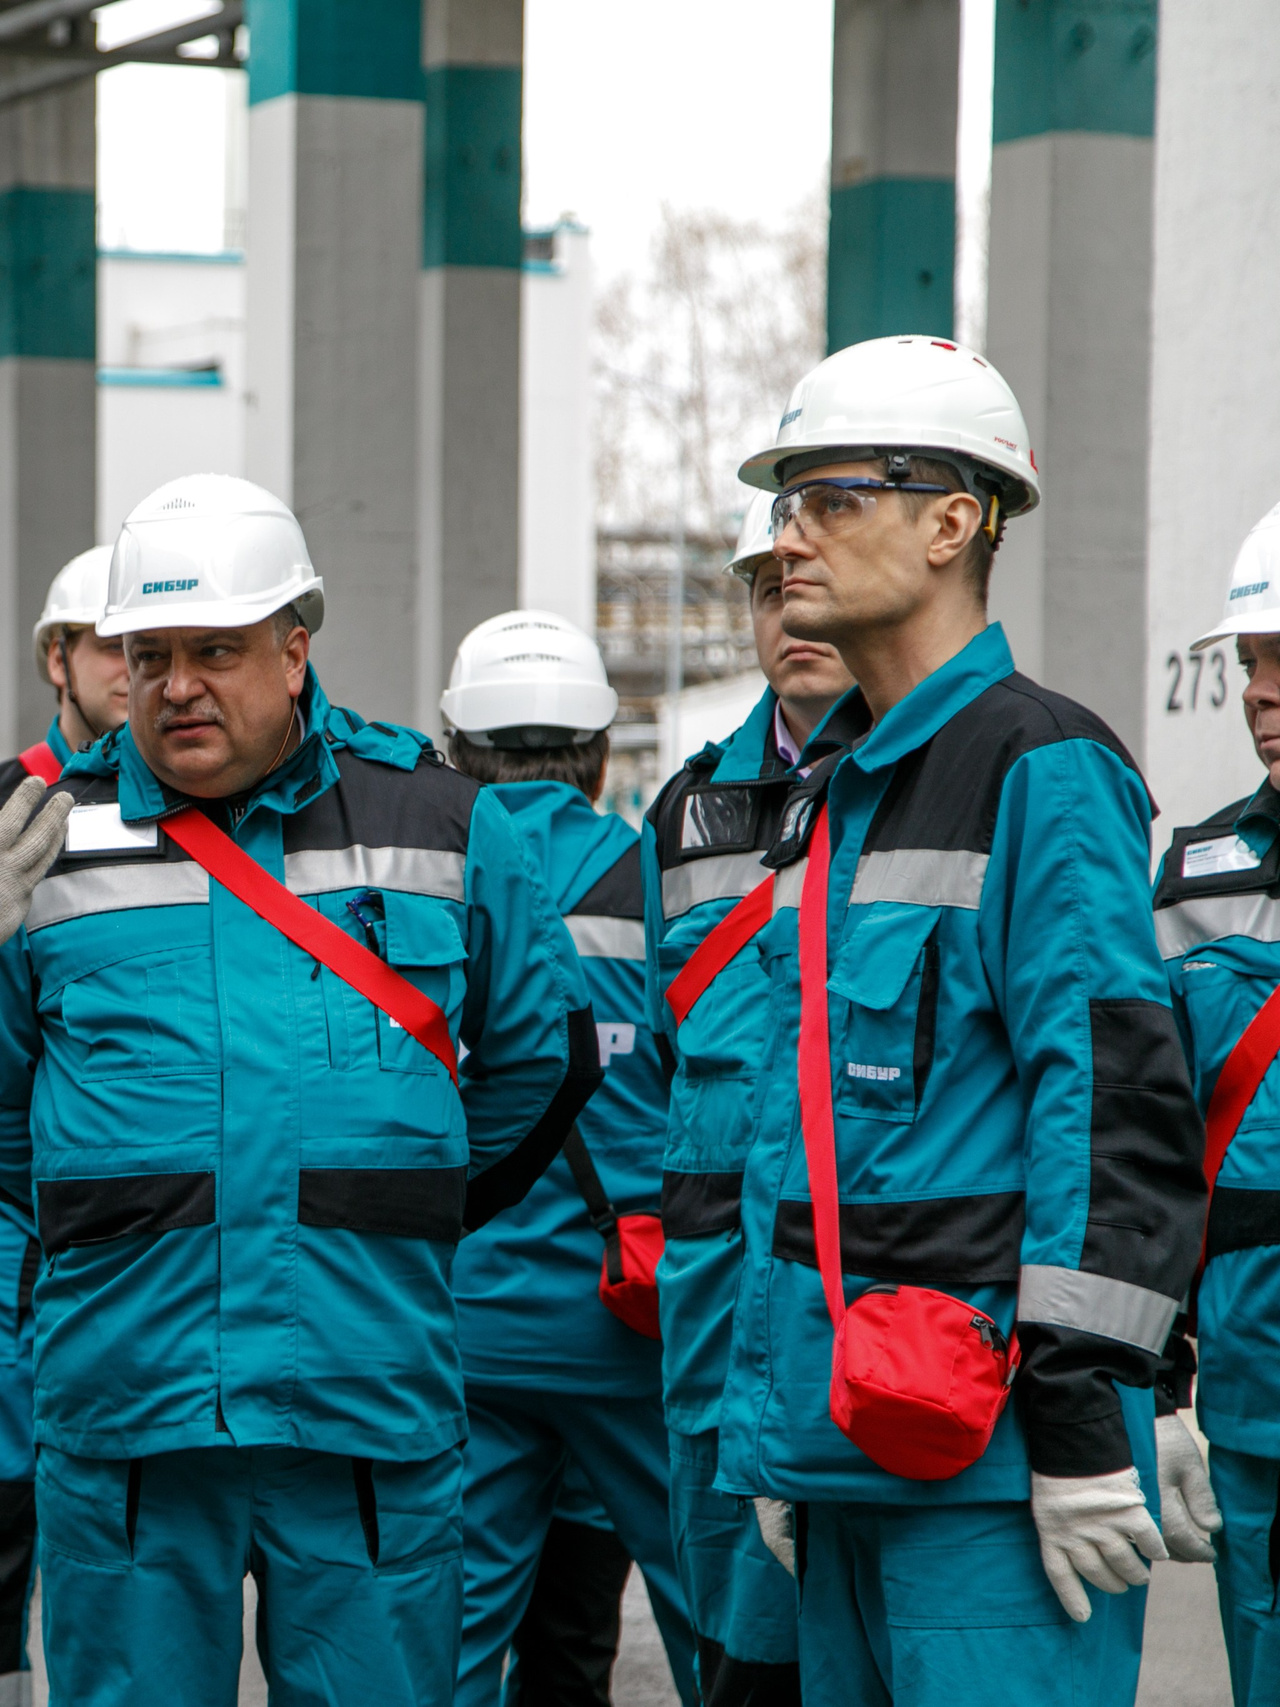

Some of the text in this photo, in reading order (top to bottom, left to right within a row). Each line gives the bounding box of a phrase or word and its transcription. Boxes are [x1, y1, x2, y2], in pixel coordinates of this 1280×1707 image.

[142, 578, 199, 595] СИБУР
[1229, 581, 1270, 601] СИБУР
[1166, 650, 1227, 711] 273
[847, 1062, 901, 1082] СИБУР
